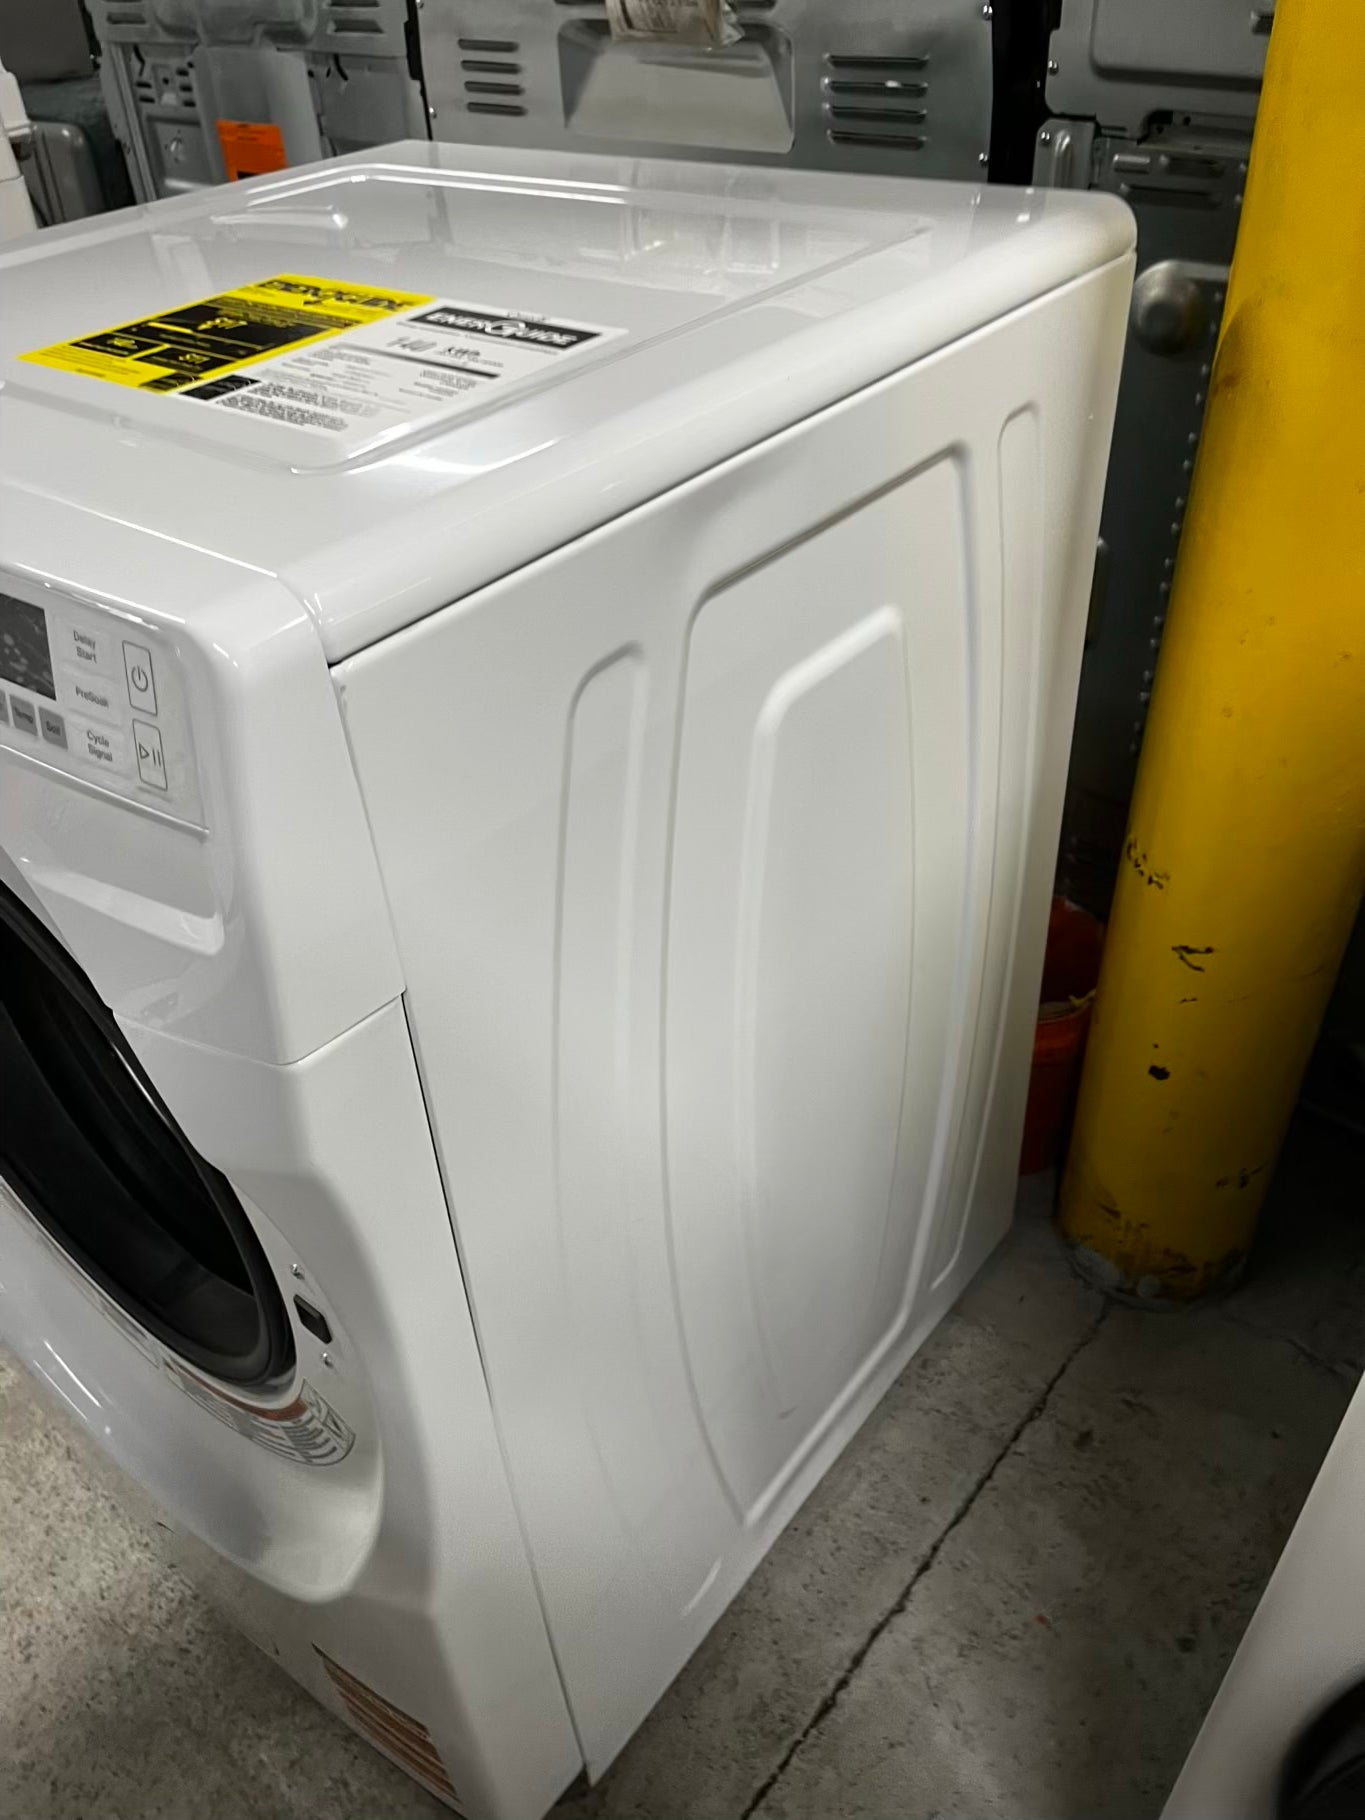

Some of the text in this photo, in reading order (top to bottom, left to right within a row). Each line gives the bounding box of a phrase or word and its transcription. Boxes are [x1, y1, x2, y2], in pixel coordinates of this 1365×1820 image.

[73, 629, 96, 651] Delay
[76, 645, 97, 664] Start
[86, 729, 110, 748] Cycle
[87, 742, 113, 762] Signal
